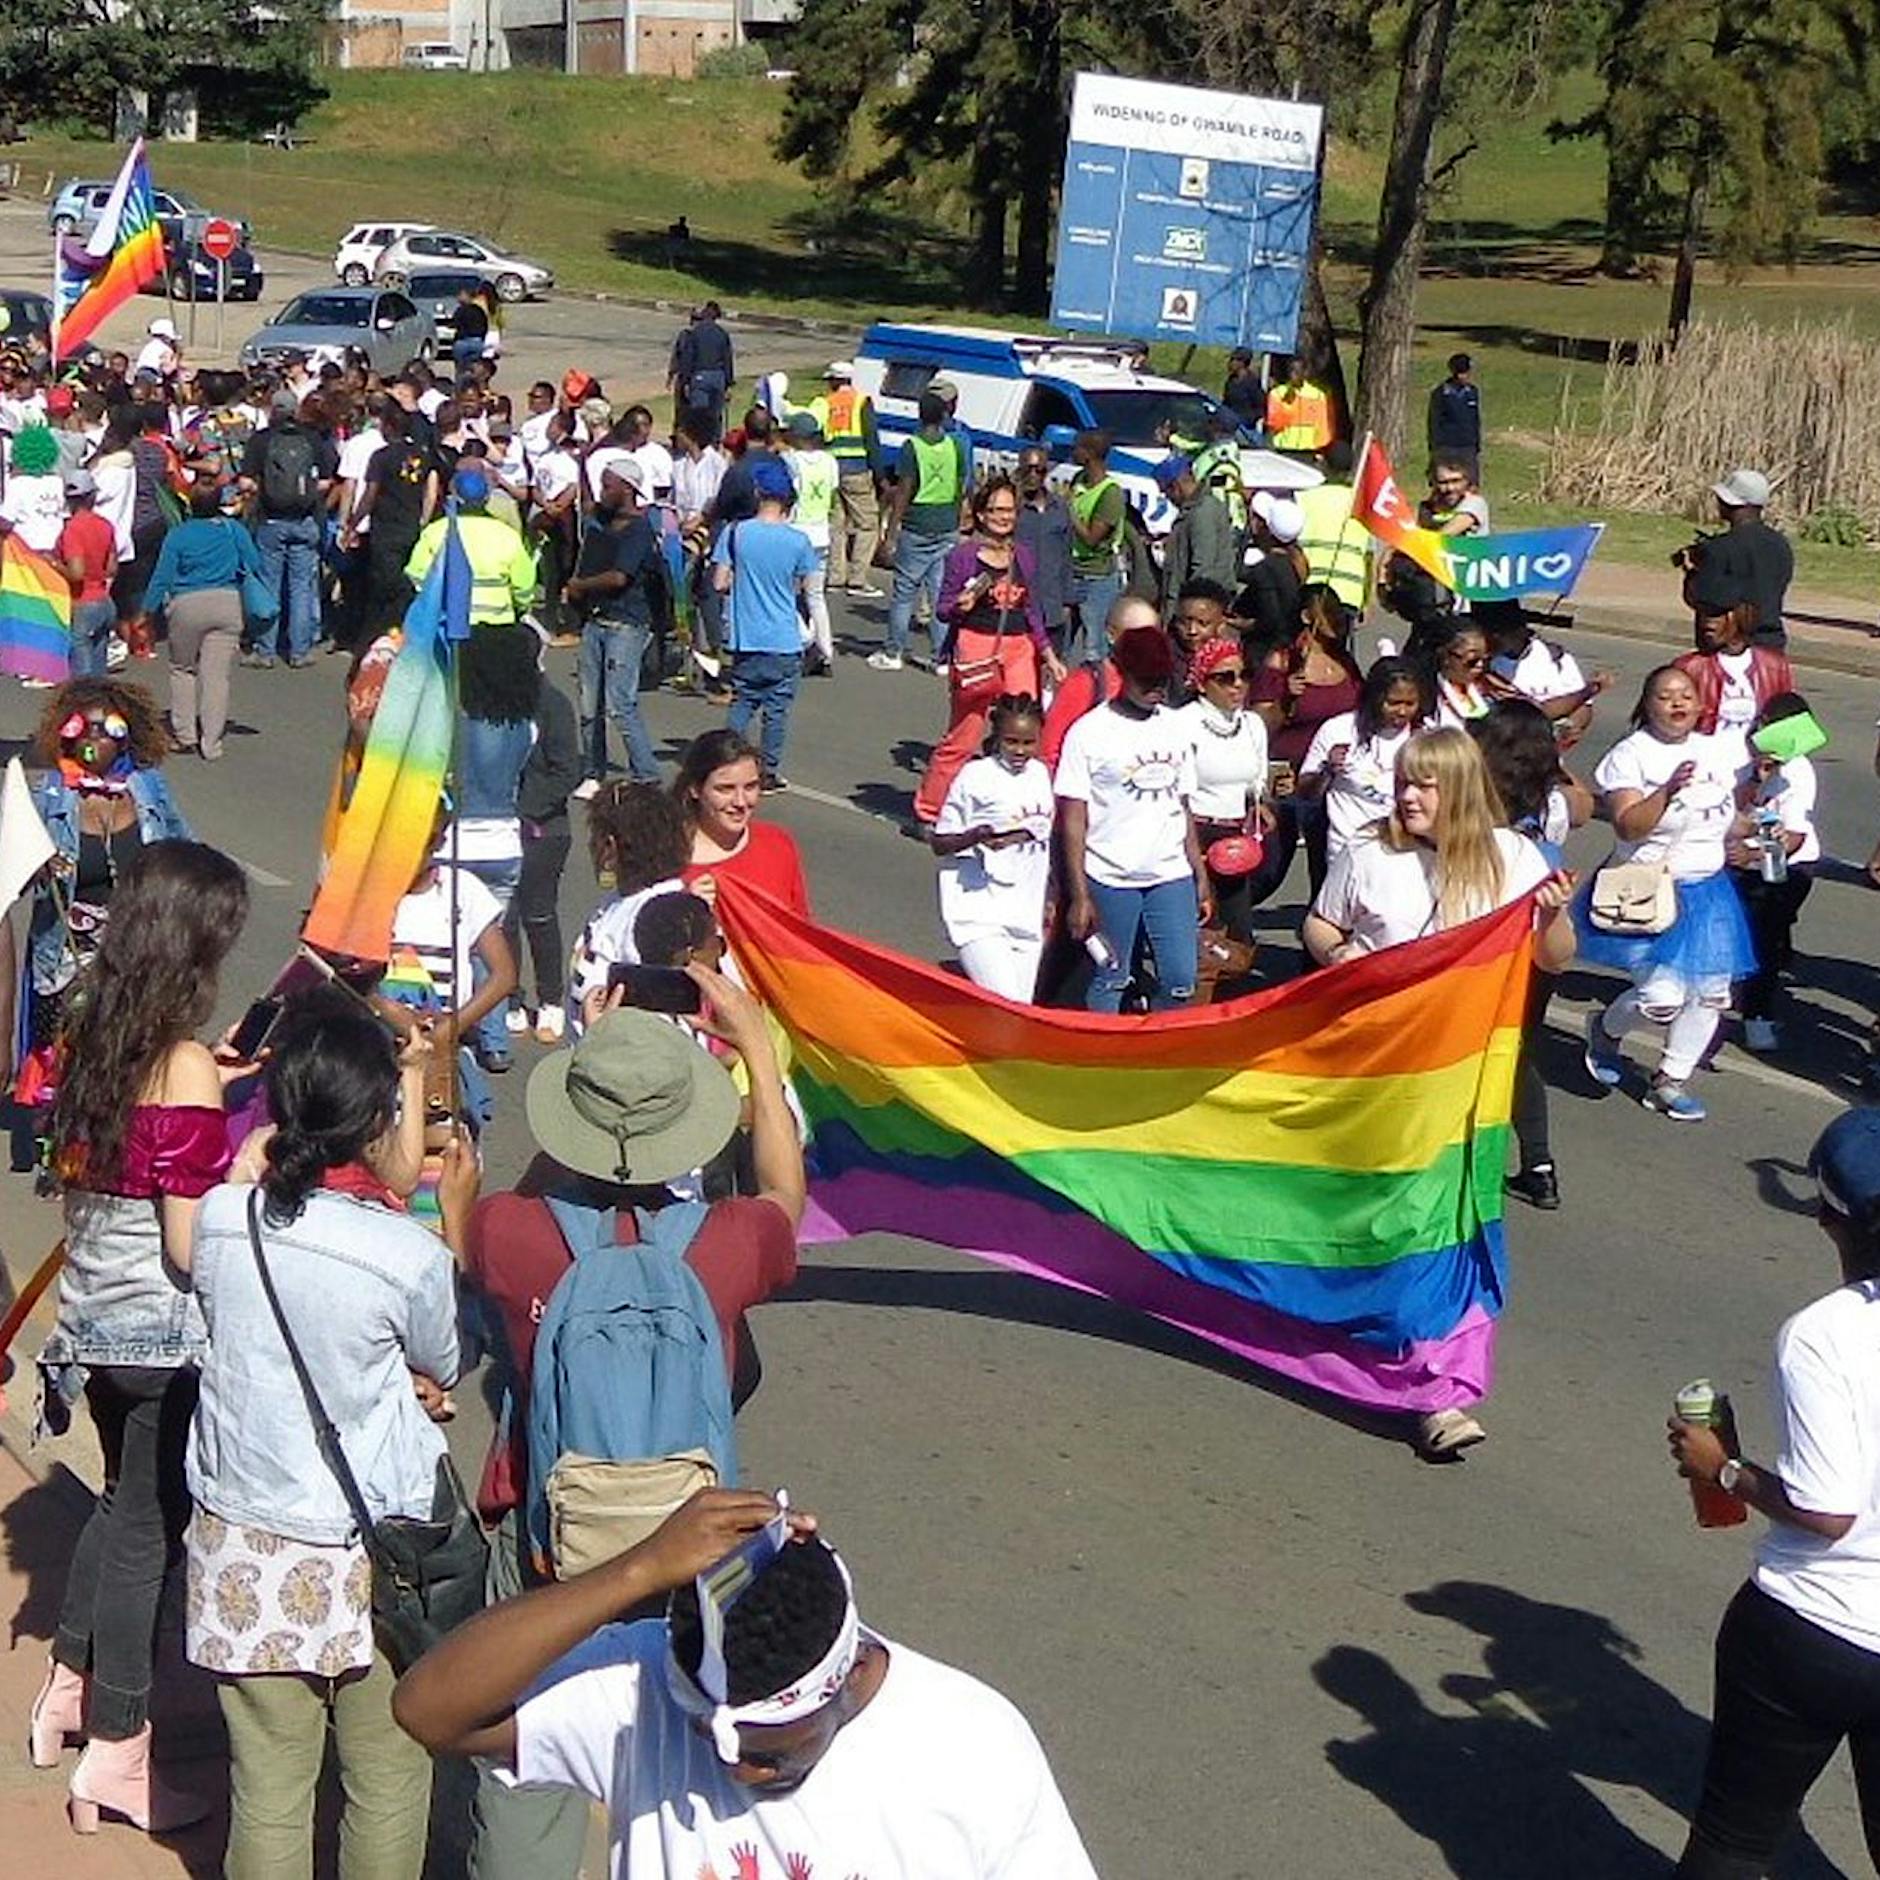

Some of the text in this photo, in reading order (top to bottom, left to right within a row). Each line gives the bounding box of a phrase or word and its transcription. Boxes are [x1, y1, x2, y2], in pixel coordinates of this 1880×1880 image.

[1092, 103, 1166, 124] WIDENING
[1170, 113, 1188, 126] OF
[1262, 126, 1304, 144] ROAD
